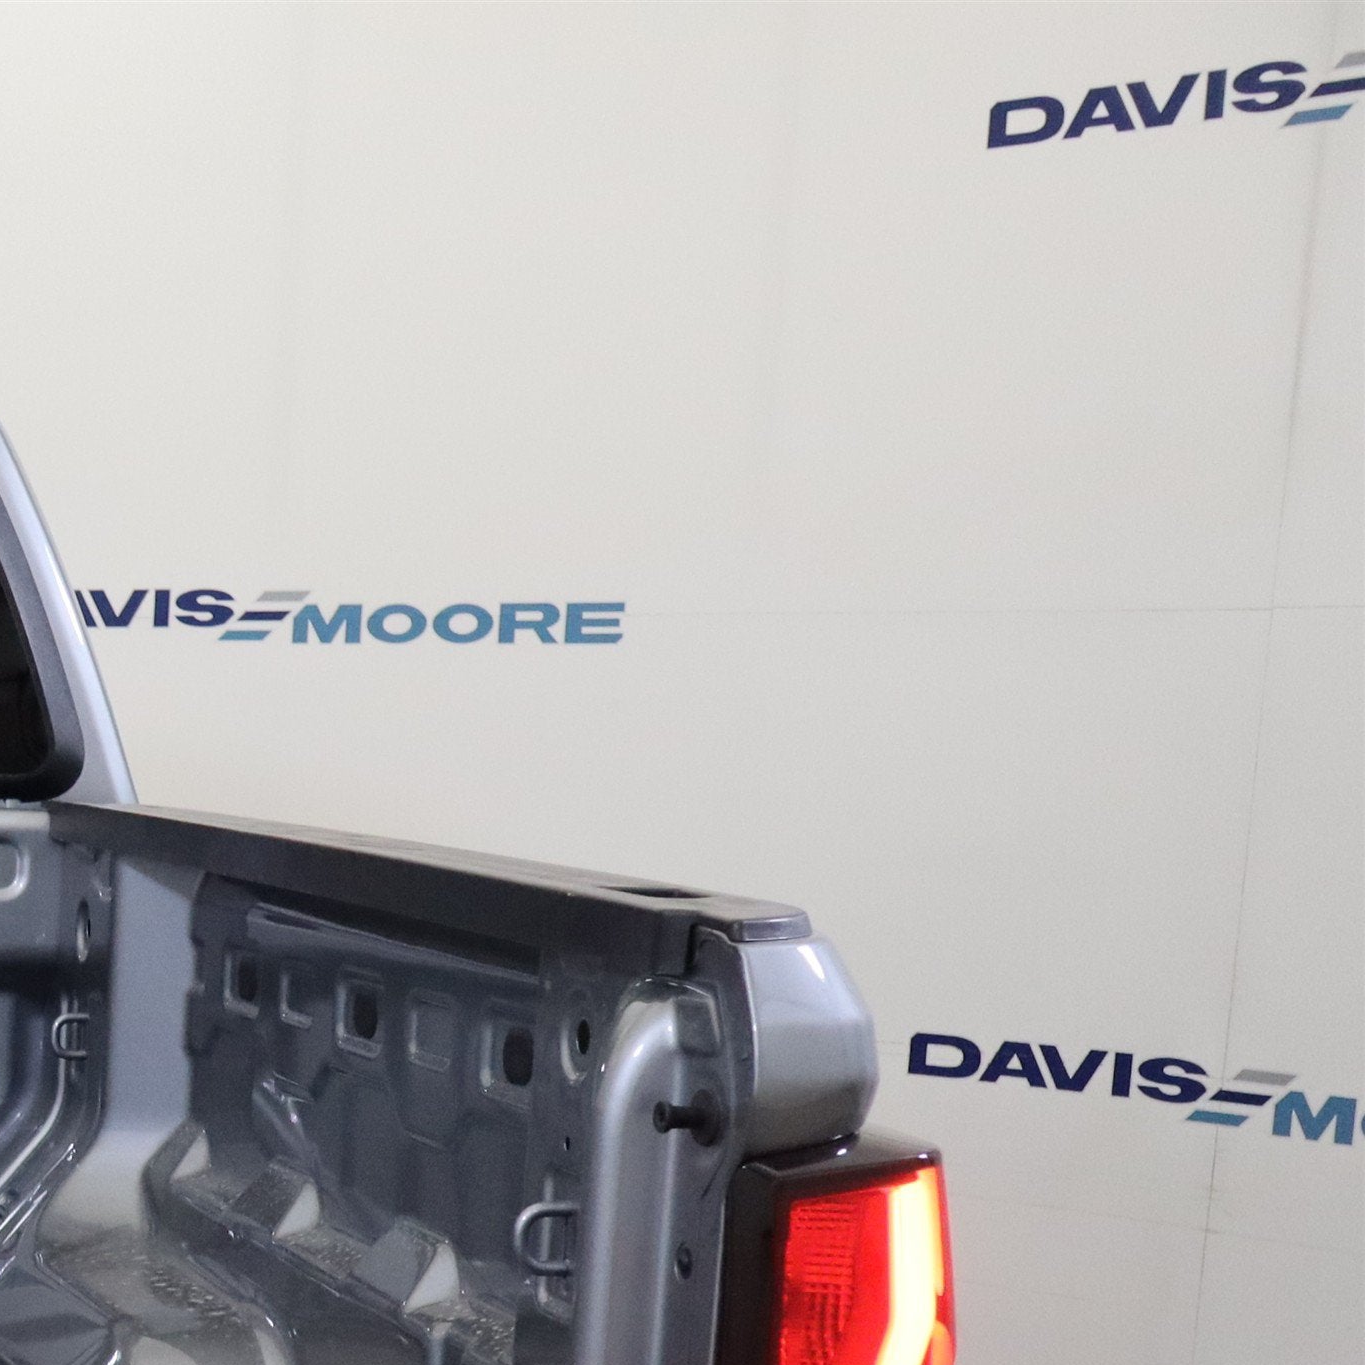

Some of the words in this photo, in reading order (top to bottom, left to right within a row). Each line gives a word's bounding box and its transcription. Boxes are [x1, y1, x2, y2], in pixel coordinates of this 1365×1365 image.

[987, 60, 1307, 149] DAVIS
[74, 588, 235, 629] VIS
[291, 602, 626, 645] MOORE
[908, 1032, 1209, 1104] DAVIS
